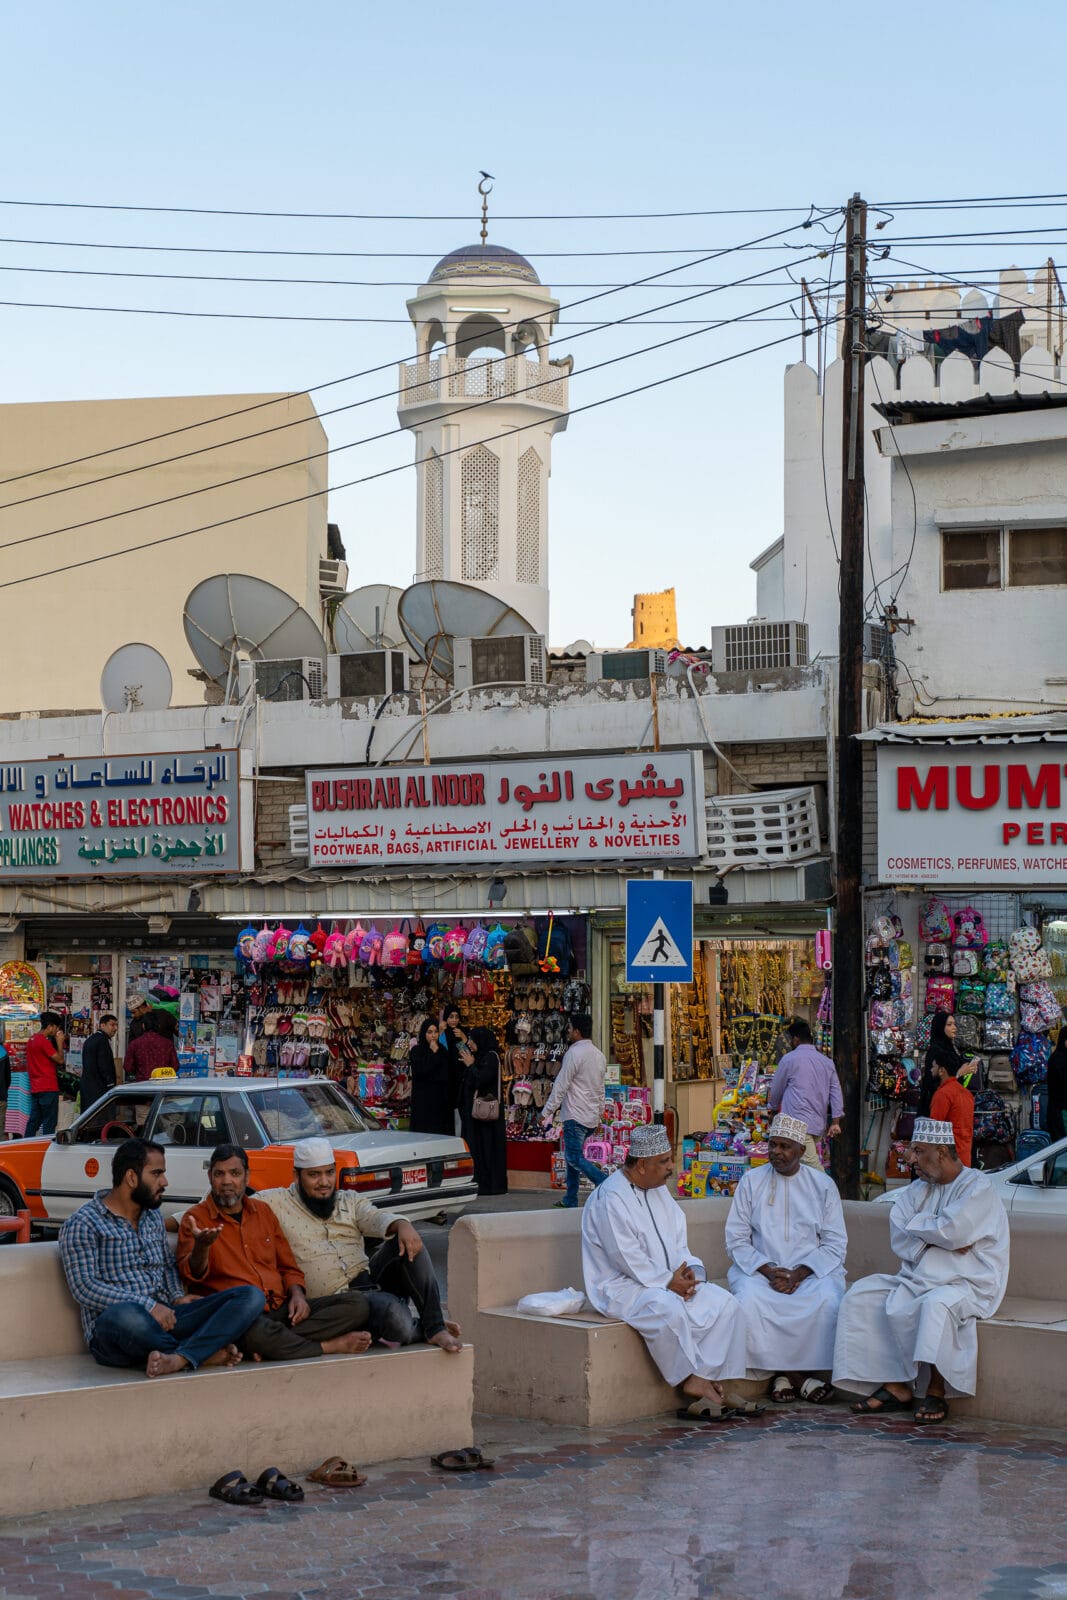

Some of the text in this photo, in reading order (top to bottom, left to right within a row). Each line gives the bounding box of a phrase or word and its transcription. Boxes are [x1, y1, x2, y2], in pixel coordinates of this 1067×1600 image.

[55, 760, 154, 789] للساعات
[35, 774, 46, 799] و
[312, 774, 486, 811] BUSHRAH AL NOOR
[498, 763, 684, 811] بشرى النور
[897, 764, 1067, 809] MUM
[9, 802, 85, 830] WATCHES
[90, 800, 103, 827] &
[108, 796, 227, 826] ELECTRONICS
[314, 825, 383, 842] الكماليات
[389, 829, 397, 841] و
[542, 823, 549, 836] و
[618, 822, 627, 834] و
[1003, 822, 1067, 845] PER
[314, 834, 680, 857] FOOTWEAR, BAGS, ARTIFICIAL JEWELLERY & NOVELTIES
[887, 857, 954, 871] COSMETICS,
[957, 858, 1020, 872] PERFUMES,
